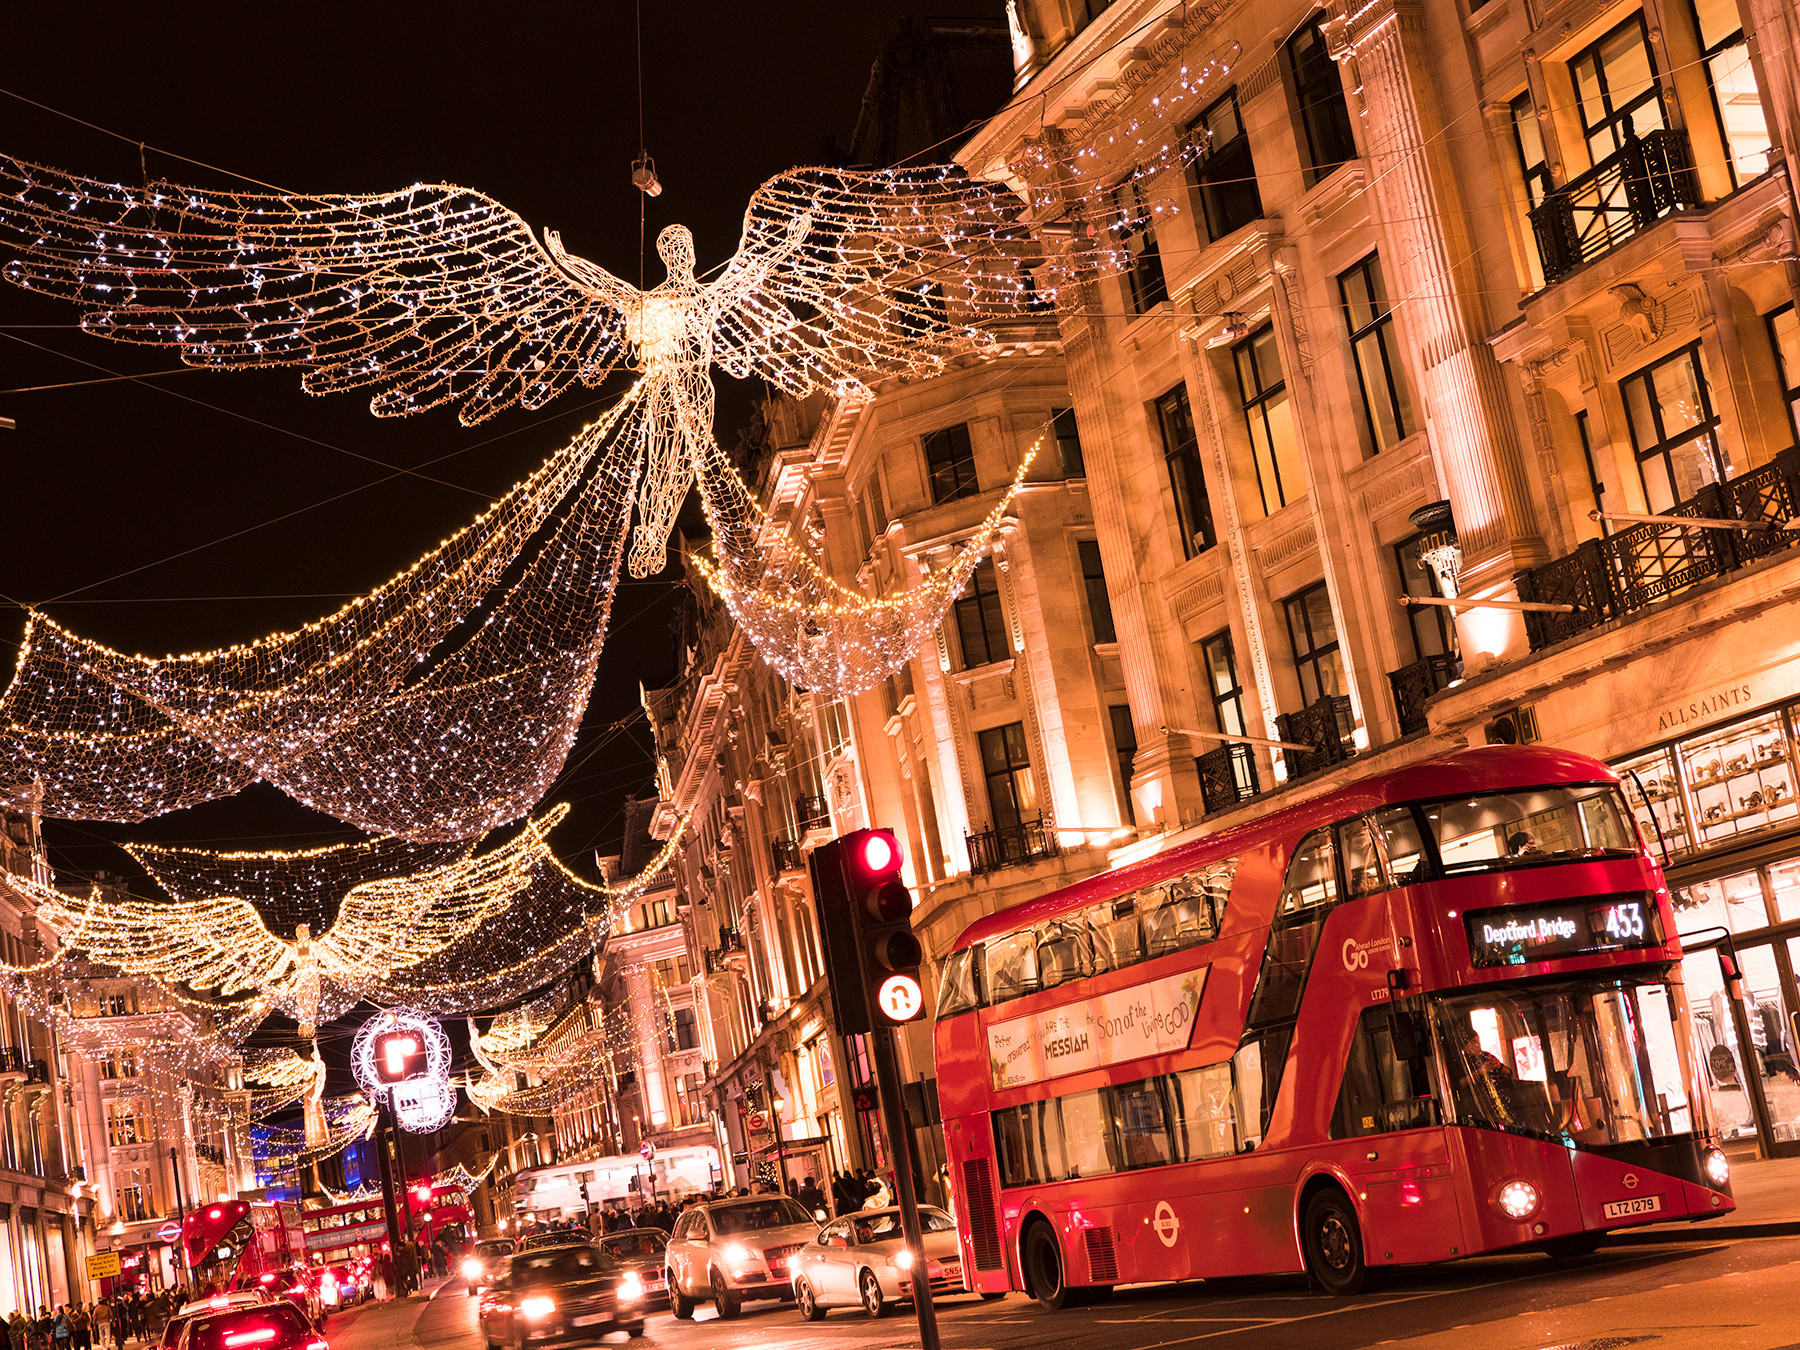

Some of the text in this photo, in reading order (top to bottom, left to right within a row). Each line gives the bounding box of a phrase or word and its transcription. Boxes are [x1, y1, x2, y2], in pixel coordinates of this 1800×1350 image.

[1658, 685, 1752, 731] ALLSAINTS
[1484, 916, 1577, 947] Deptford Bridge
[1606, 902, 1644, 939] 453
[1342, 937, 1369, 972] Go
[1370, 987, 1389, 1001] LT279
[1096, 1001, 1147, 1040] Son of the
[1141, 1011, 1164, 1039] Living
[993, 1034, 1012, 1049] Peter
[1044, 1032, 1090, 1060] MESSIAH
